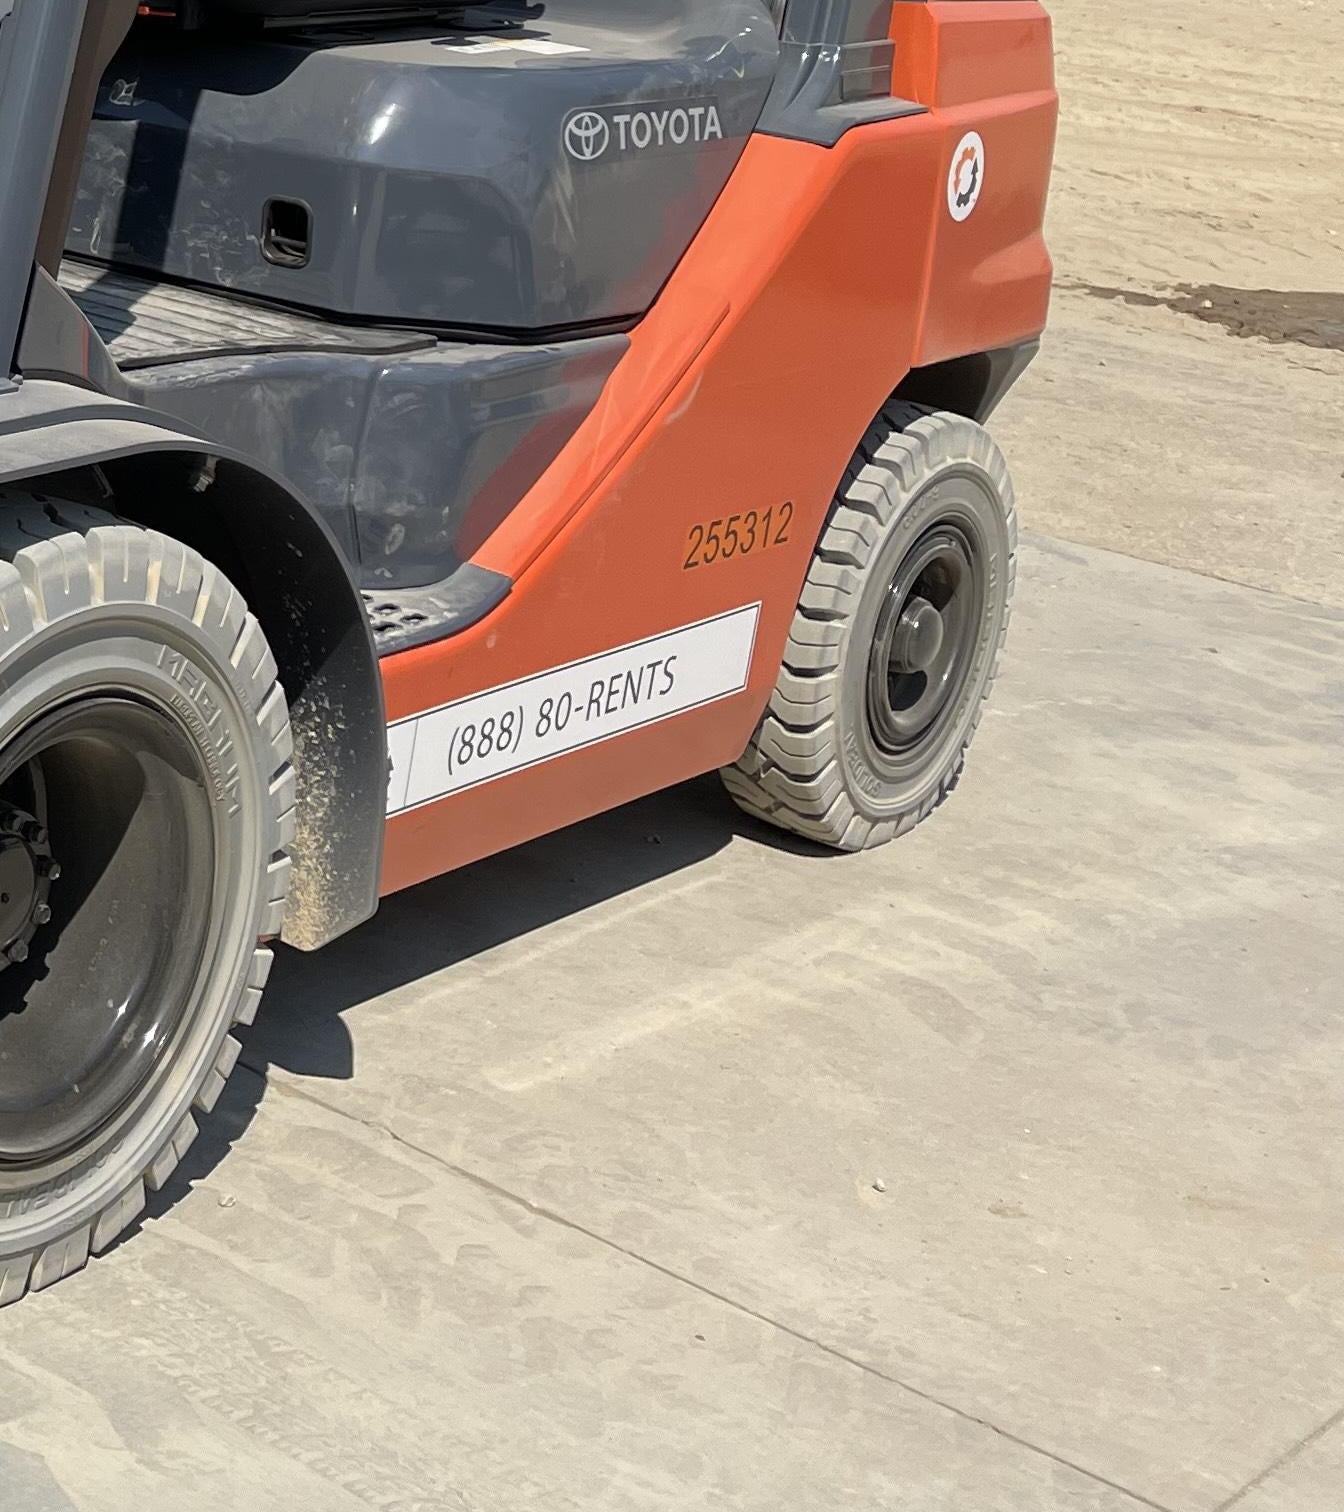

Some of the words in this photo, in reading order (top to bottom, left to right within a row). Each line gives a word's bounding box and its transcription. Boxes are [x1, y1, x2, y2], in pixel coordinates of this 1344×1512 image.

[613, 105, 723, 150] TOYOTA
[683, 501, 793, 569] 255312
[447, 705, 523, 775] (888)
[534, 655, 678, 738] 80-RENTS
